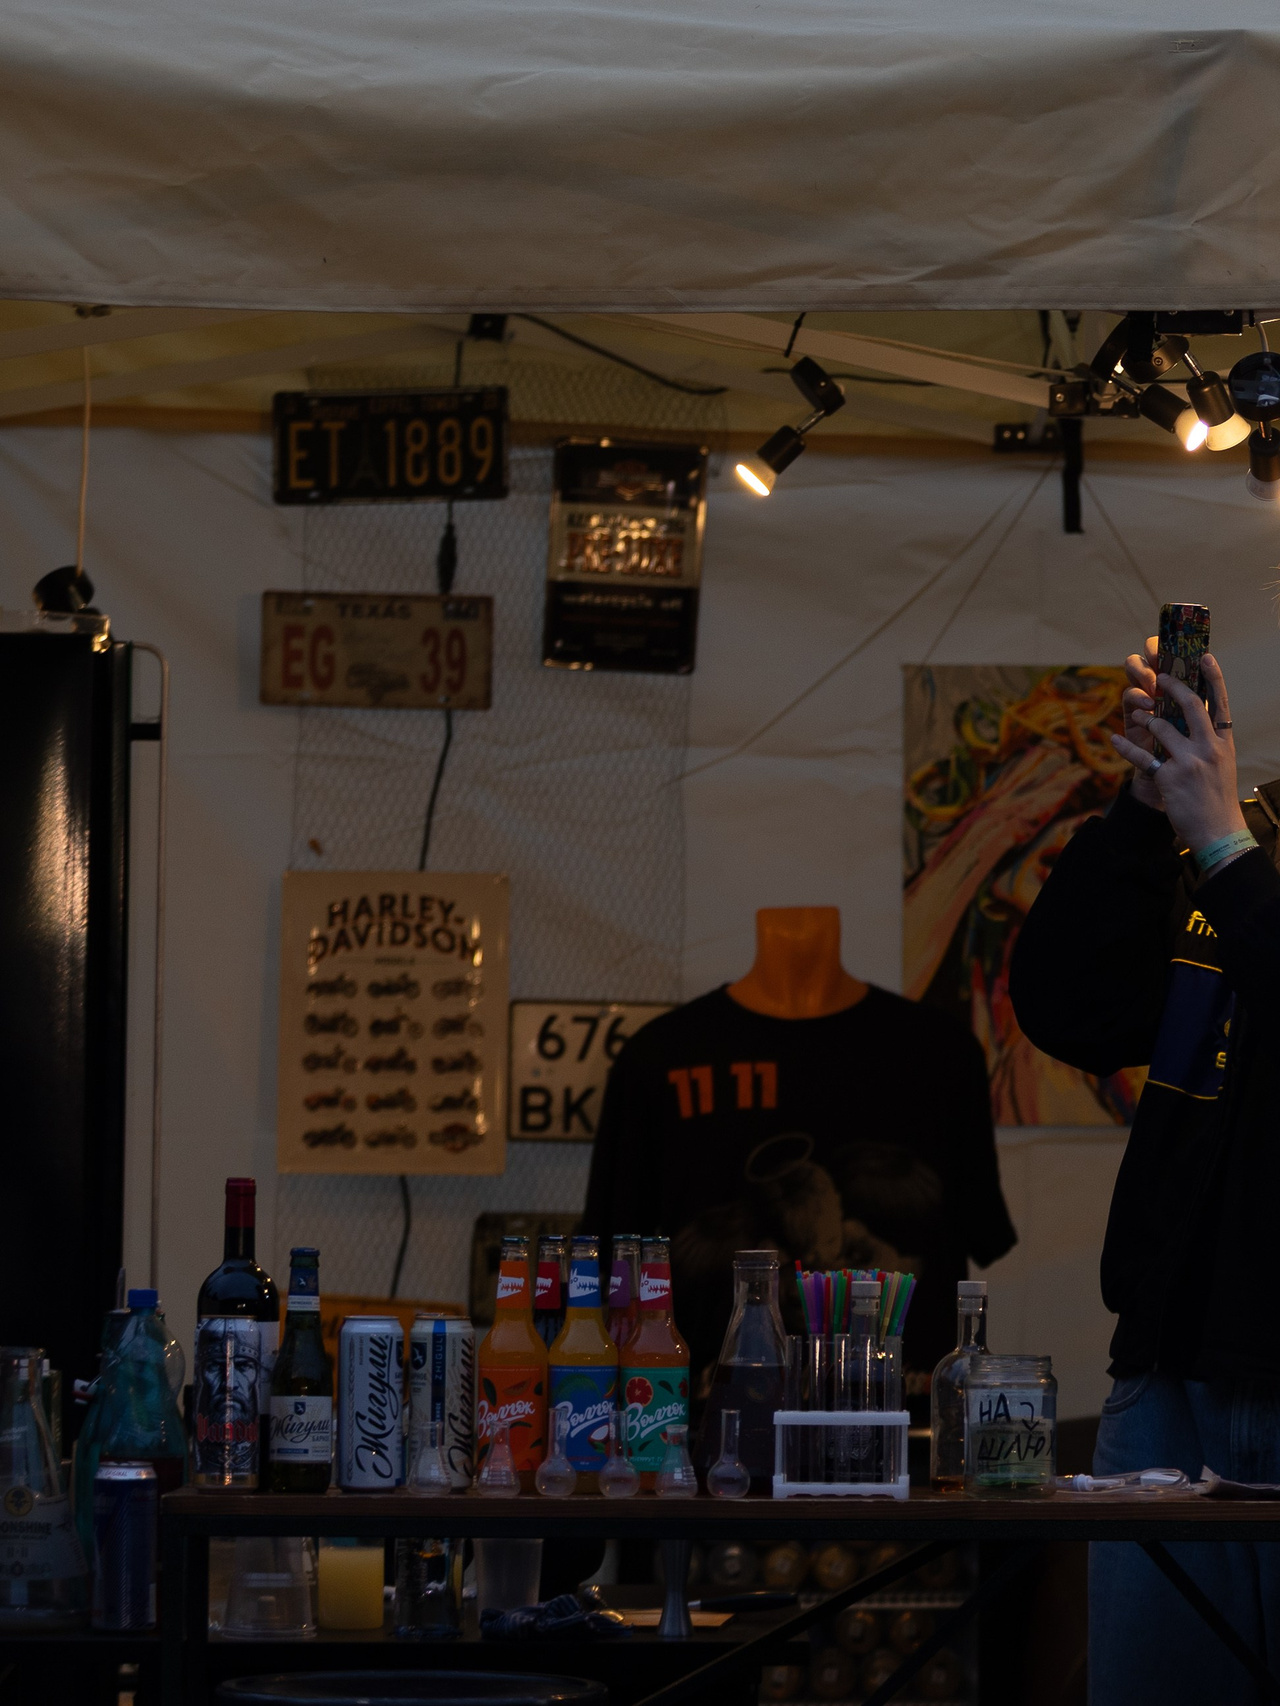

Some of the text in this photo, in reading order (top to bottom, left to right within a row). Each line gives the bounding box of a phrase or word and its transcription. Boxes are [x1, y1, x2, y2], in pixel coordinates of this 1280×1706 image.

[288, 415, 494, 490] ET 1889
[339, 603, 411, 620] TEXAS
[282, 624, 467, 693] EG 39
[327, 894, 465, 928] HARLEY-
[308, 921, 480, 963] DAVIDSON
[537, 1014, 631, 1062] 676
[0, 1521, 52, 1535] ONSHINE
